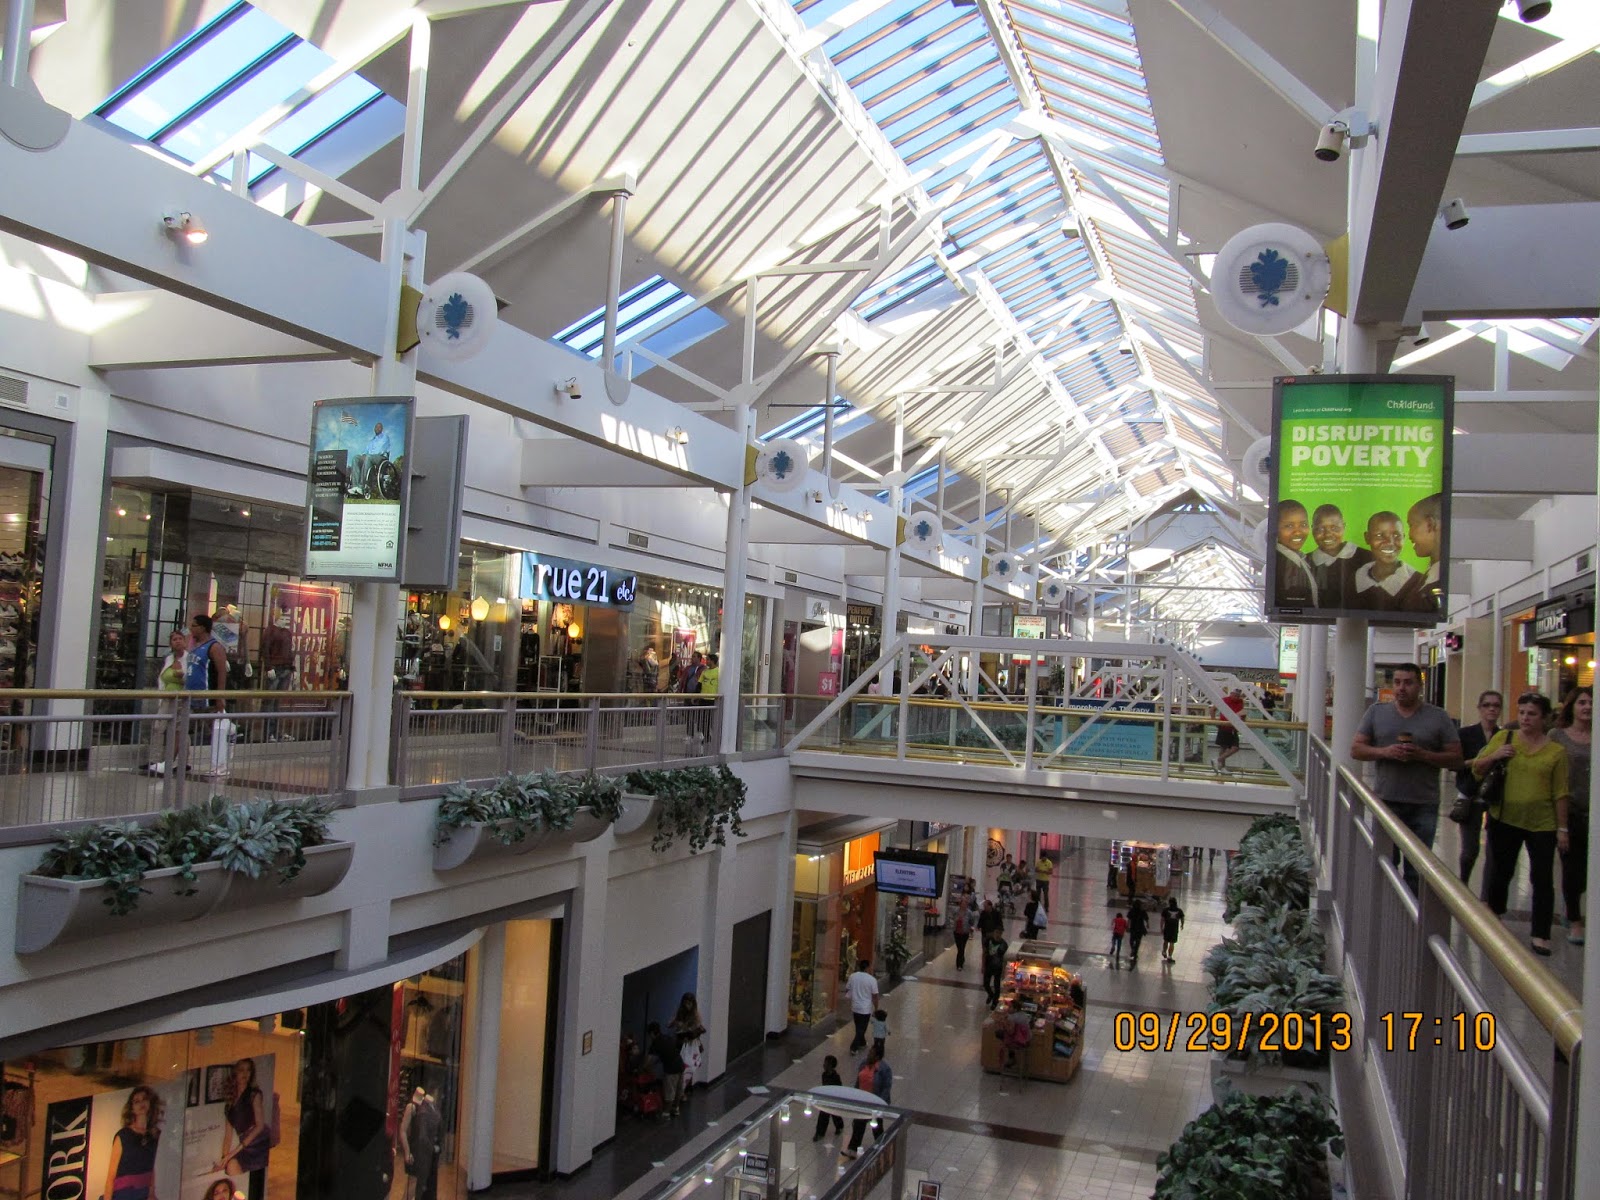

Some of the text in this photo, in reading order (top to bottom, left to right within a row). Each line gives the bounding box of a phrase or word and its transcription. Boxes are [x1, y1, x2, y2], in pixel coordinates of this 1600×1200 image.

[1292, 425, 1434, 443] DISRUPTING
[1291, 445, 1434, 468] POVERTY
[534, 563, 582, 600] rue
[586, 567, 609, 602] 21
[847, 604, 873, 616] PERFUME
[291, 606, 328, 635] FALL
[849, 615, 870, 625] OUTLET
[821, 678, 833, 691] $1
[1059, 703, 1150, 713] Cmprehenve Trapy
